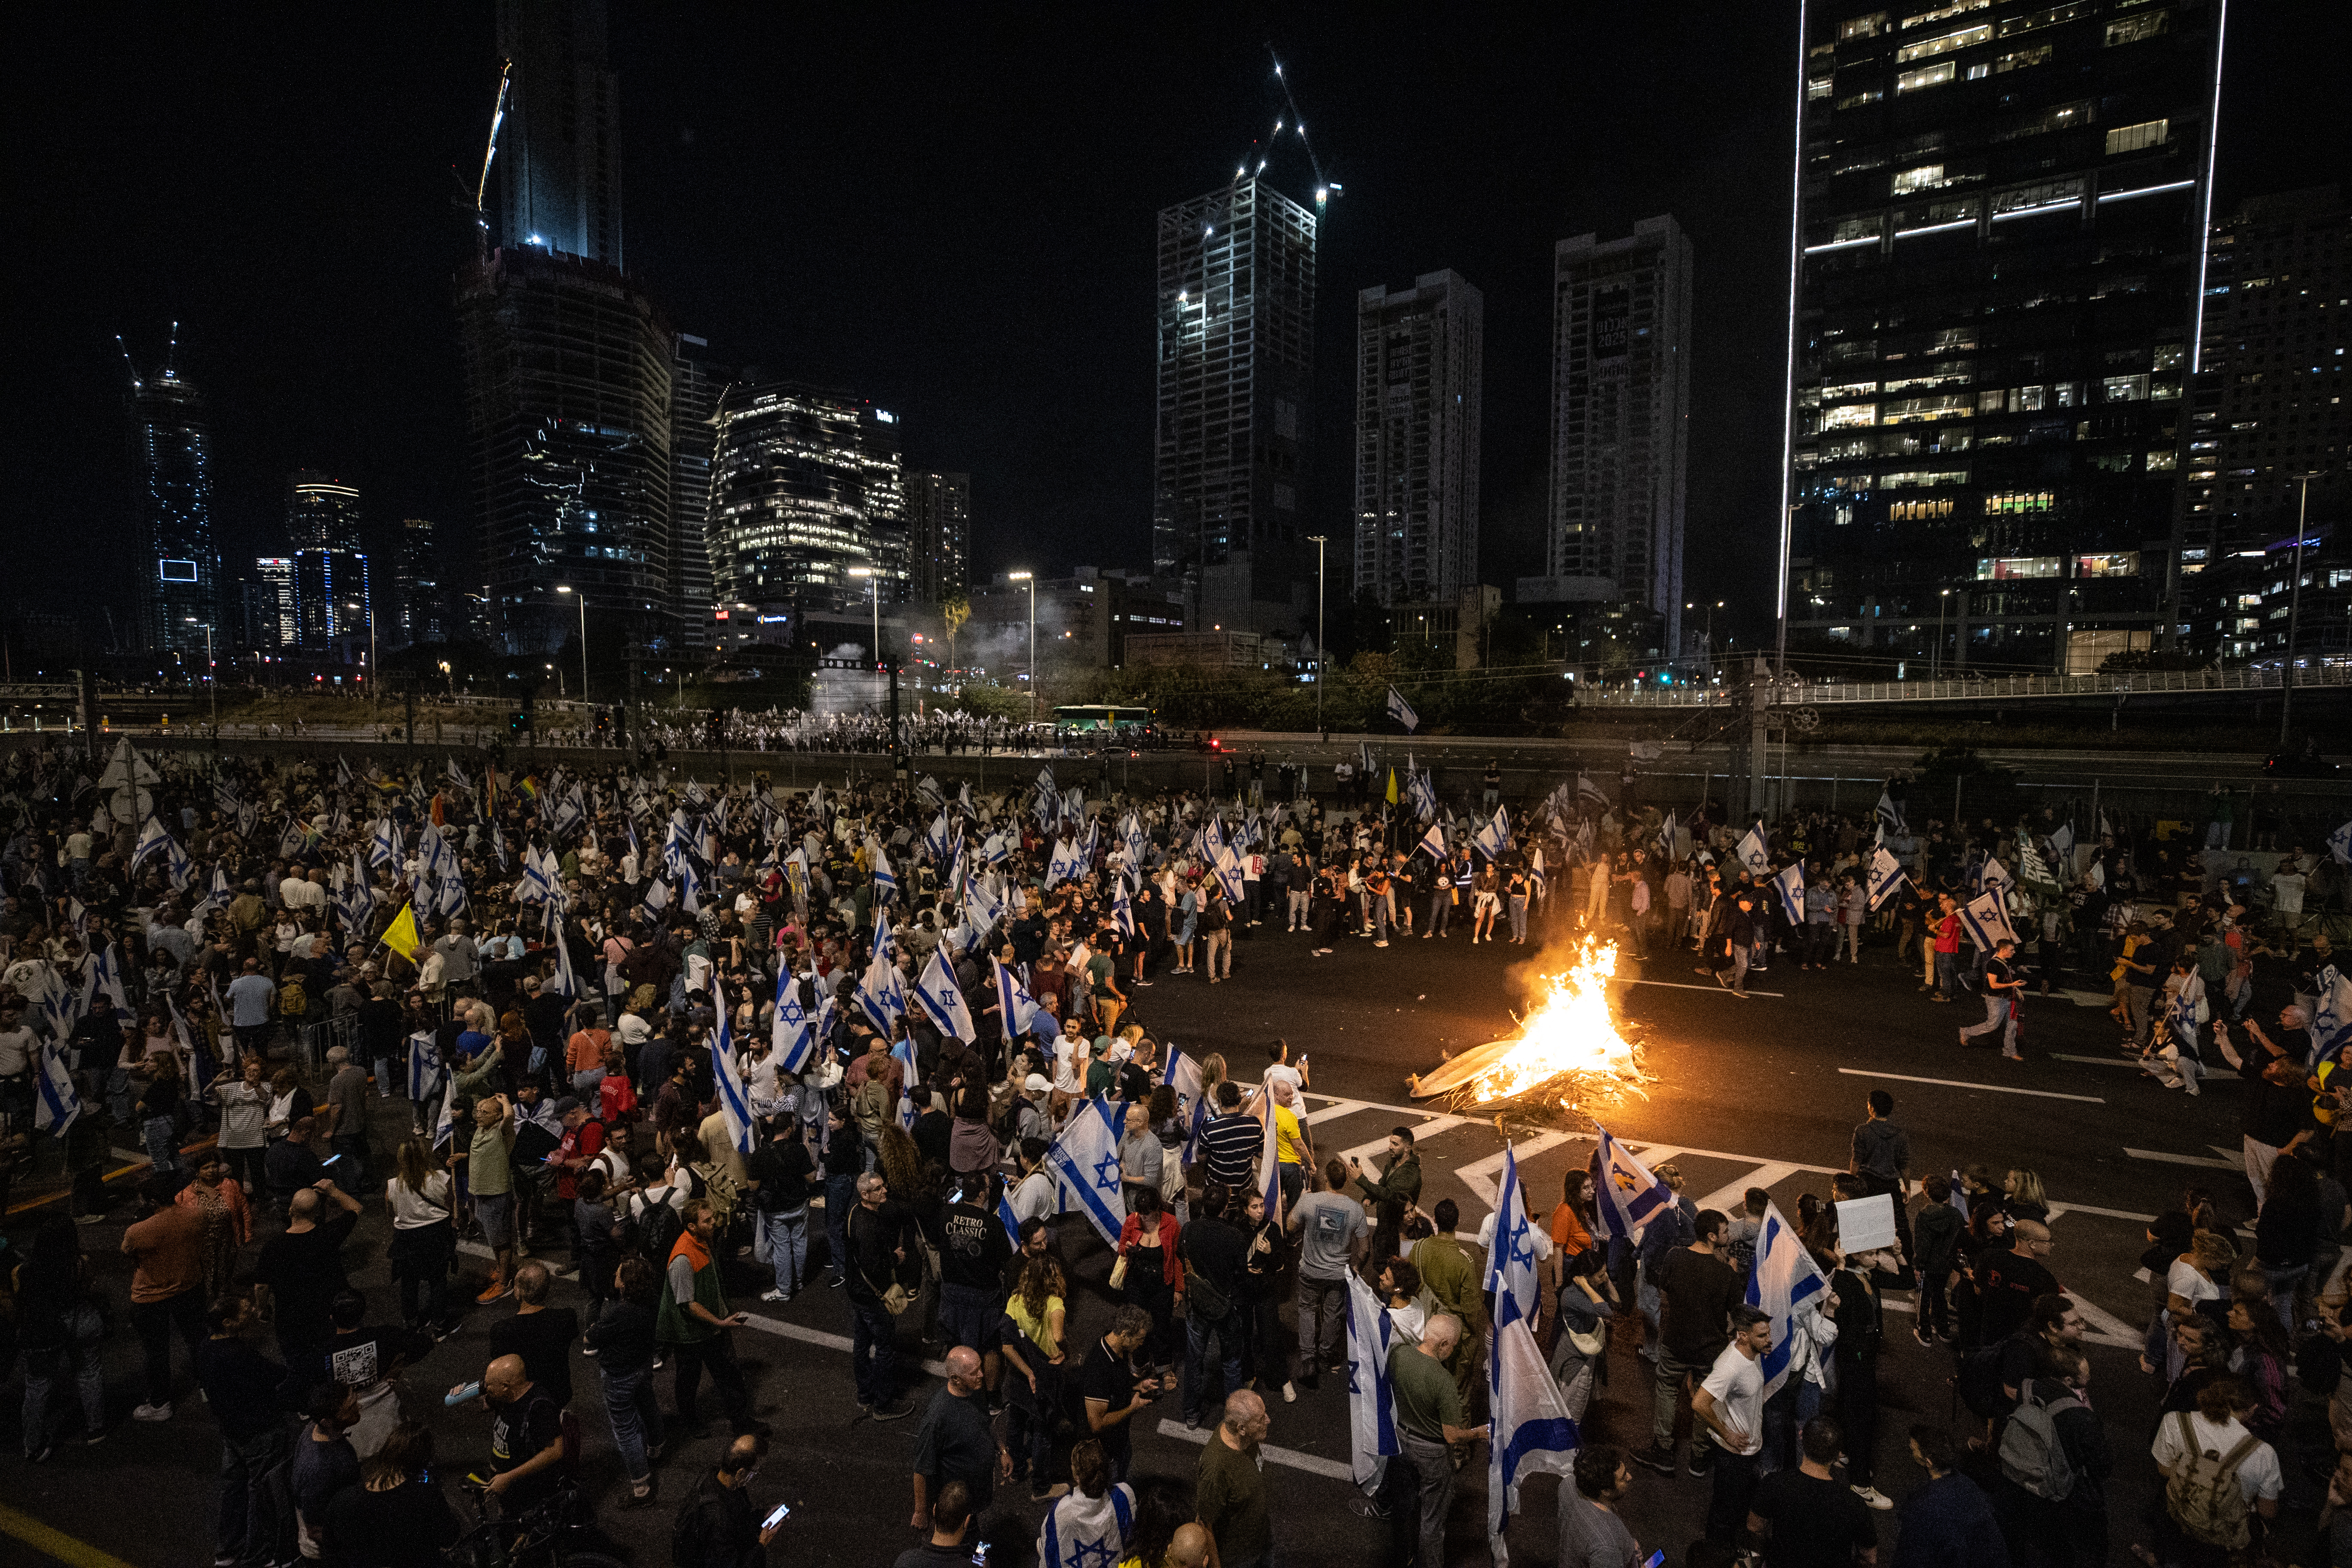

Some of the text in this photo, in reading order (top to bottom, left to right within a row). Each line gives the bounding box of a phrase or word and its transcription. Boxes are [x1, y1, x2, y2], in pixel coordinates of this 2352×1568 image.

[1597, 331, 1626, 349] 2025
[953, 1215, 983, 1228] RETRO
[946, 1222, 987, 1240] CLASSIC
